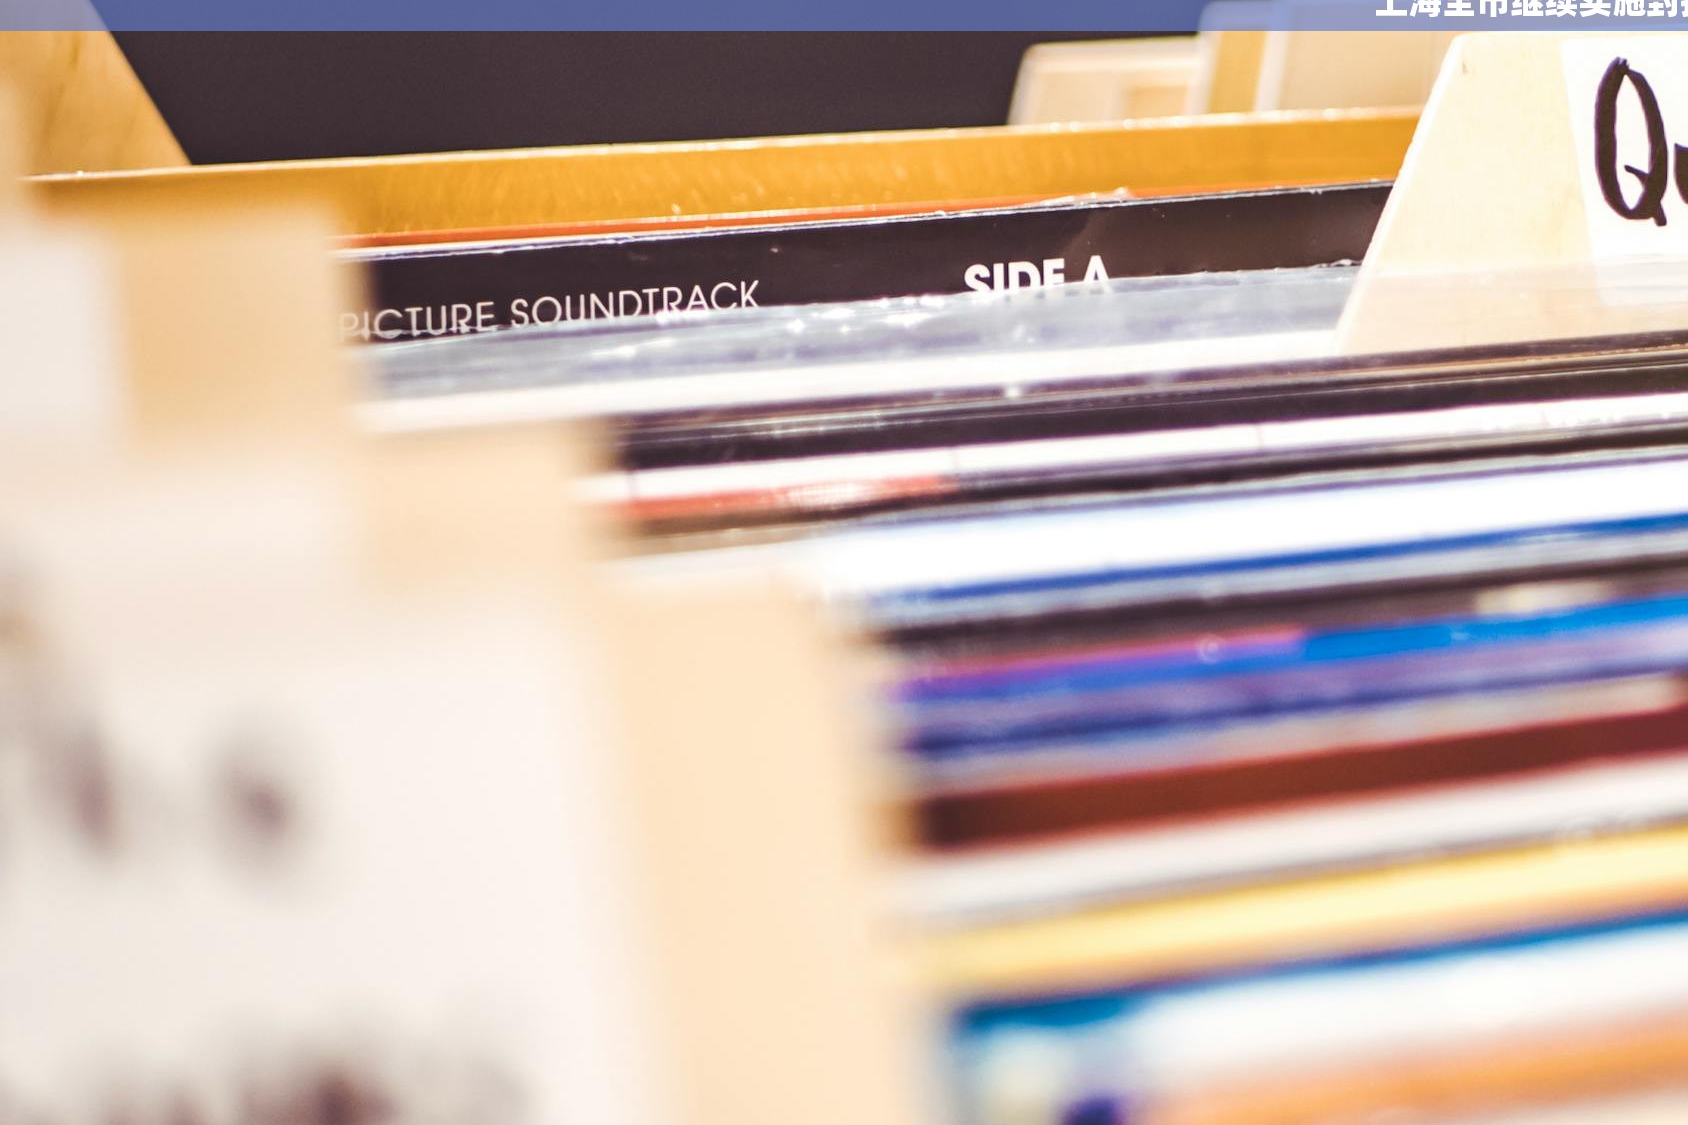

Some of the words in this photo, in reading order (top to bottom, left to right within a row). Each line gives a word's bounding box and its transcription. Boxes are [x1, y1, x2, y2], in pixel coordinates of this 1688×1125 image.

[964, 257, 1065, 295] SIDE
[1082, 255, 1110, 285] A
[338, 301, 498, 342] PICTURE
[510, 279, 761, 329] SOUNDTRACK
